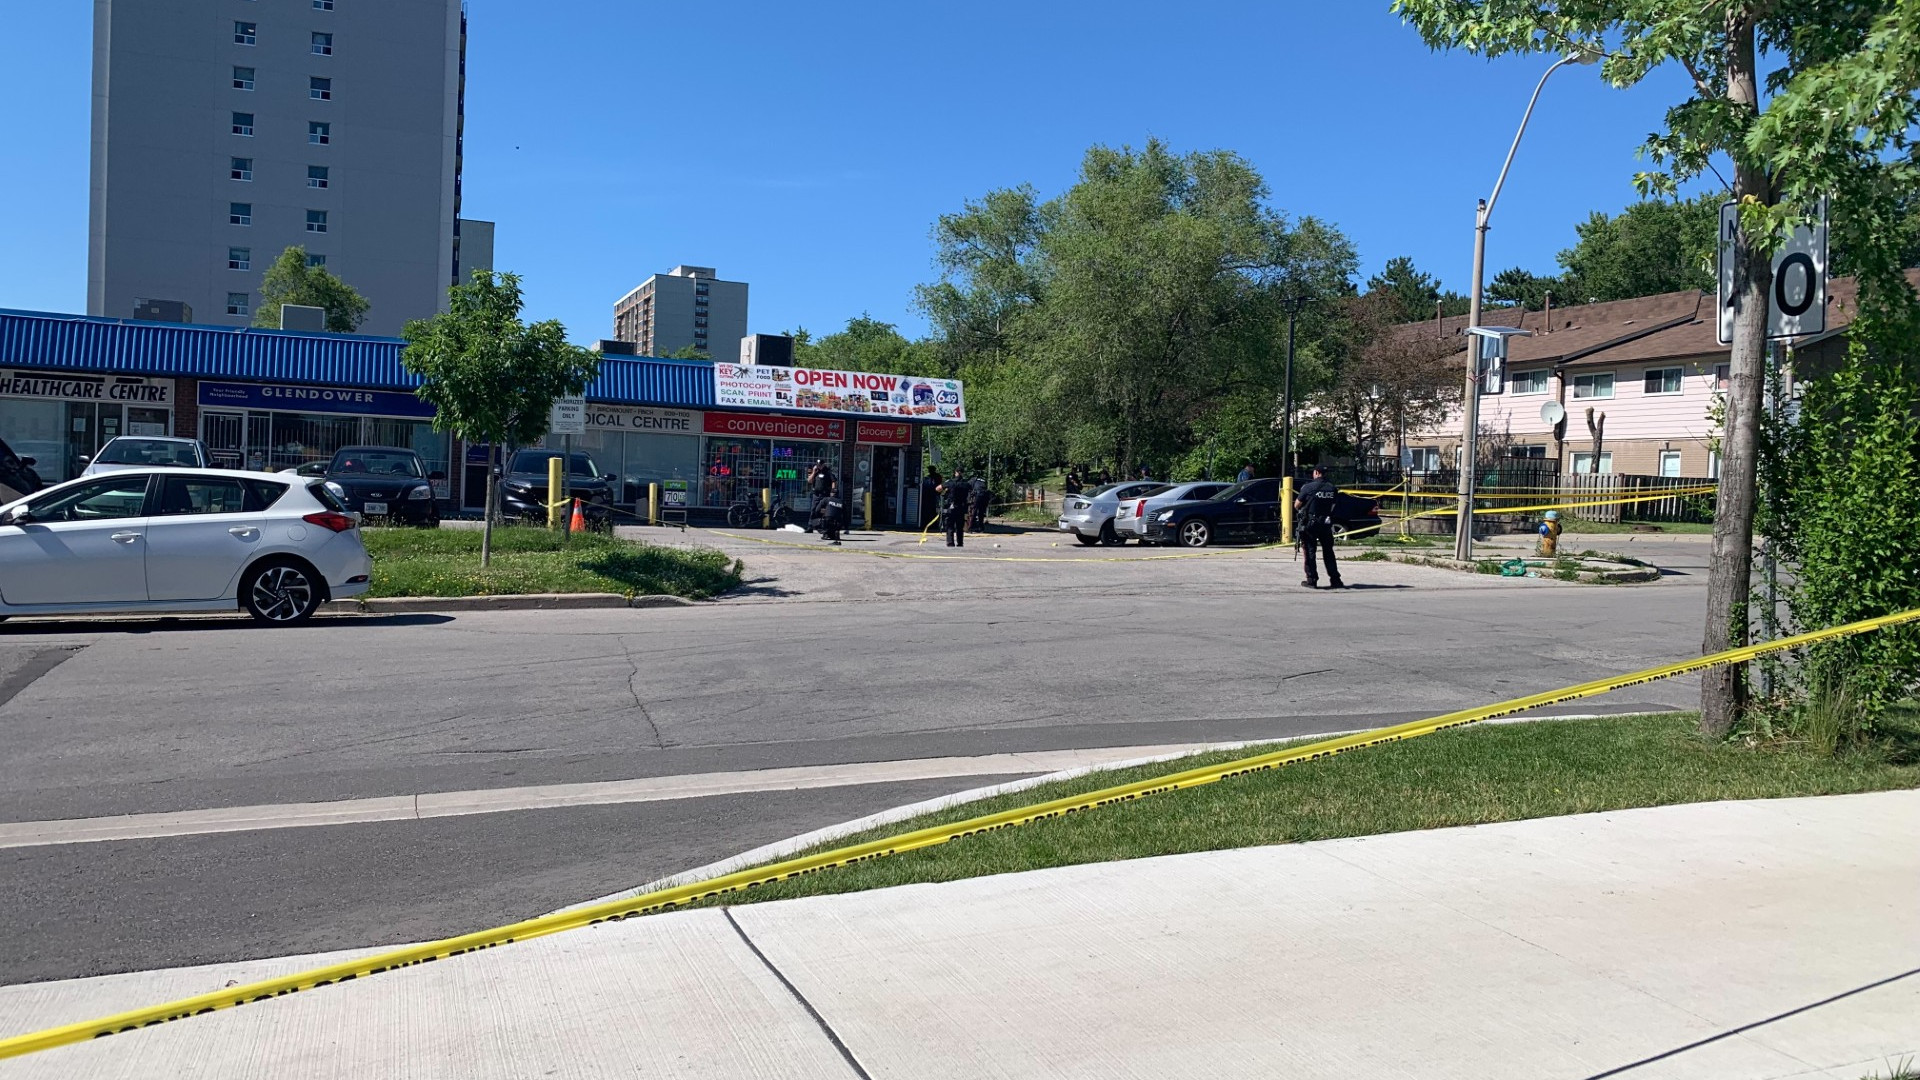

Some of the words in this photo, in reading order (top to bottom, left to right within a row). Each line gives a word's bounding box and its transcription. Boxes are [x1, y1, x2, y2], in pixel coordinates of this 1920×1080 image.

[720, 381, 772, 390] PHOTOCOPY
[794, 369, 847, 388] OPEN
[853, 374, 897, 391] NOW
[0, 378, 104, 398] HEALTHCARE
[109, 384, 168, 402] CENTRE
[261, 387, 374, 403] GLENDOWER
[584, 412, 625, 427] DICAL
[632, 416, 690, 430] CENTRE
[727, 418, 825, 435] convenience
[858, 425, 894, 439] Grocery
[775, 469, 797, 480] ATM
